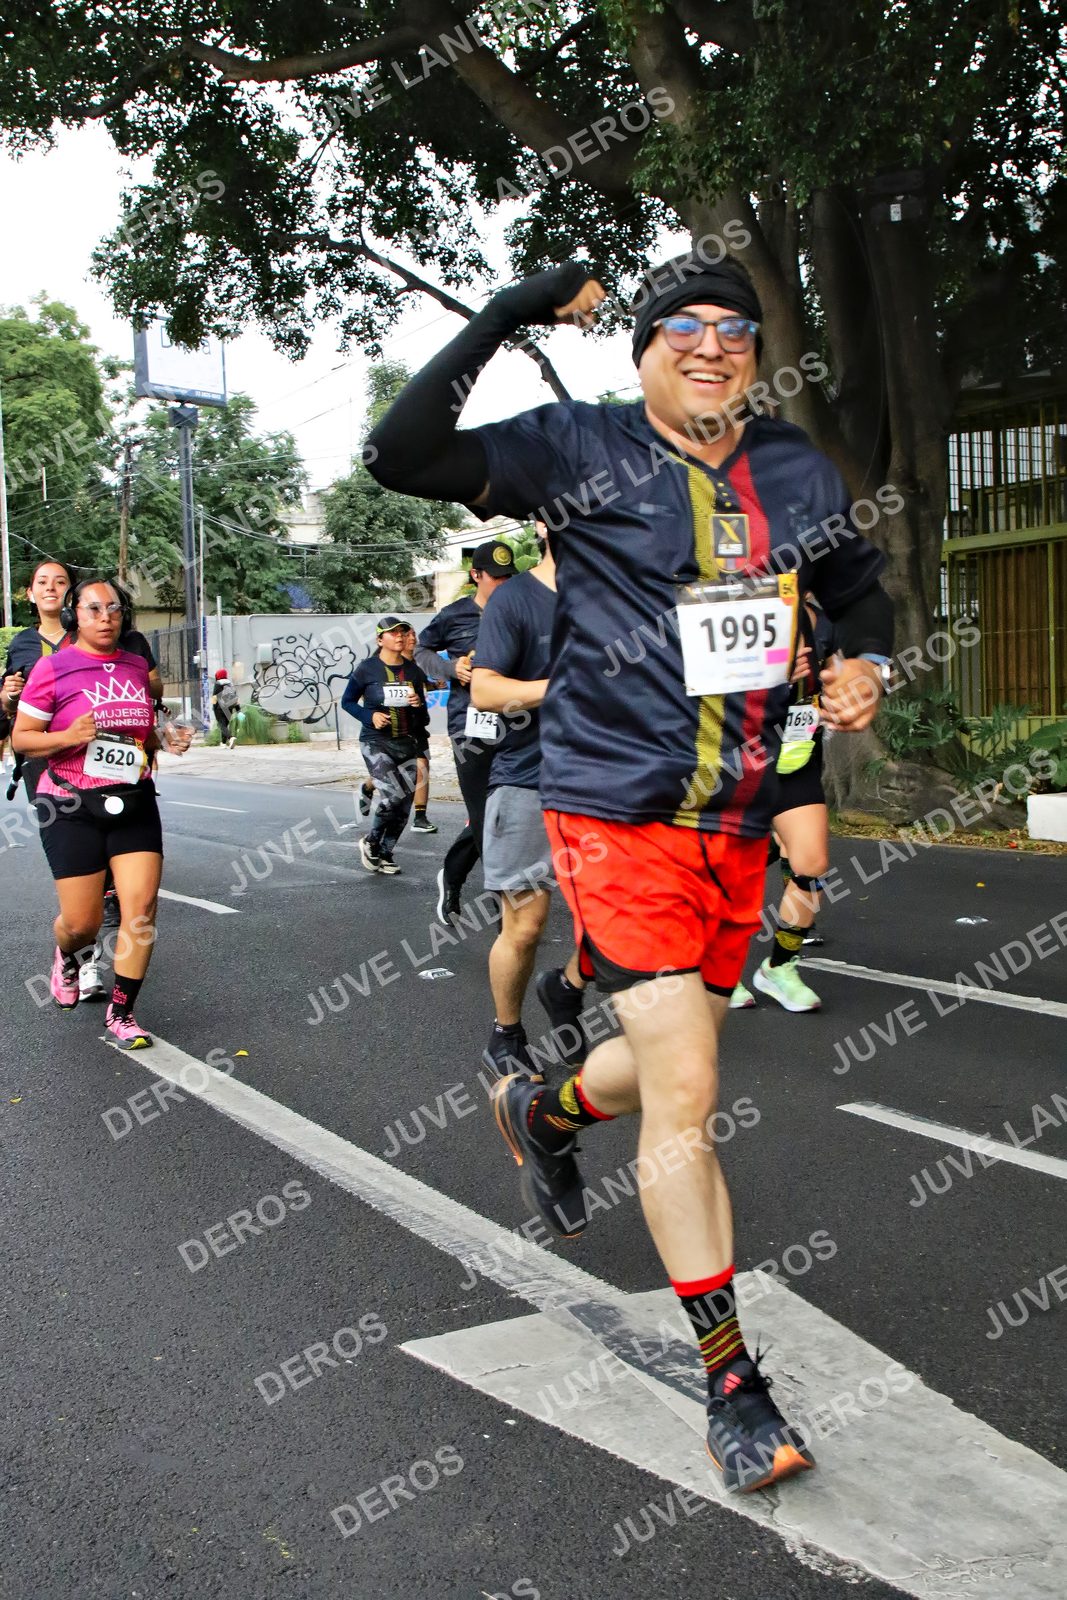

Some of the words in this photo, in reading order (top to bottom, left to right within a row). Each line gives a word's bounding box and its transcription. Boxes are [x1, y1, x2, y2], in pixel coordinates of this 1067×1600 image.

[700, 612, 777, 653] 1995
[273, 633, 313, 647] TOY
[94, 708, 149, 720] MUJERES
[95, 719, 149, 729] RUNNERAS
[94, 747, 135, 766] 3620
